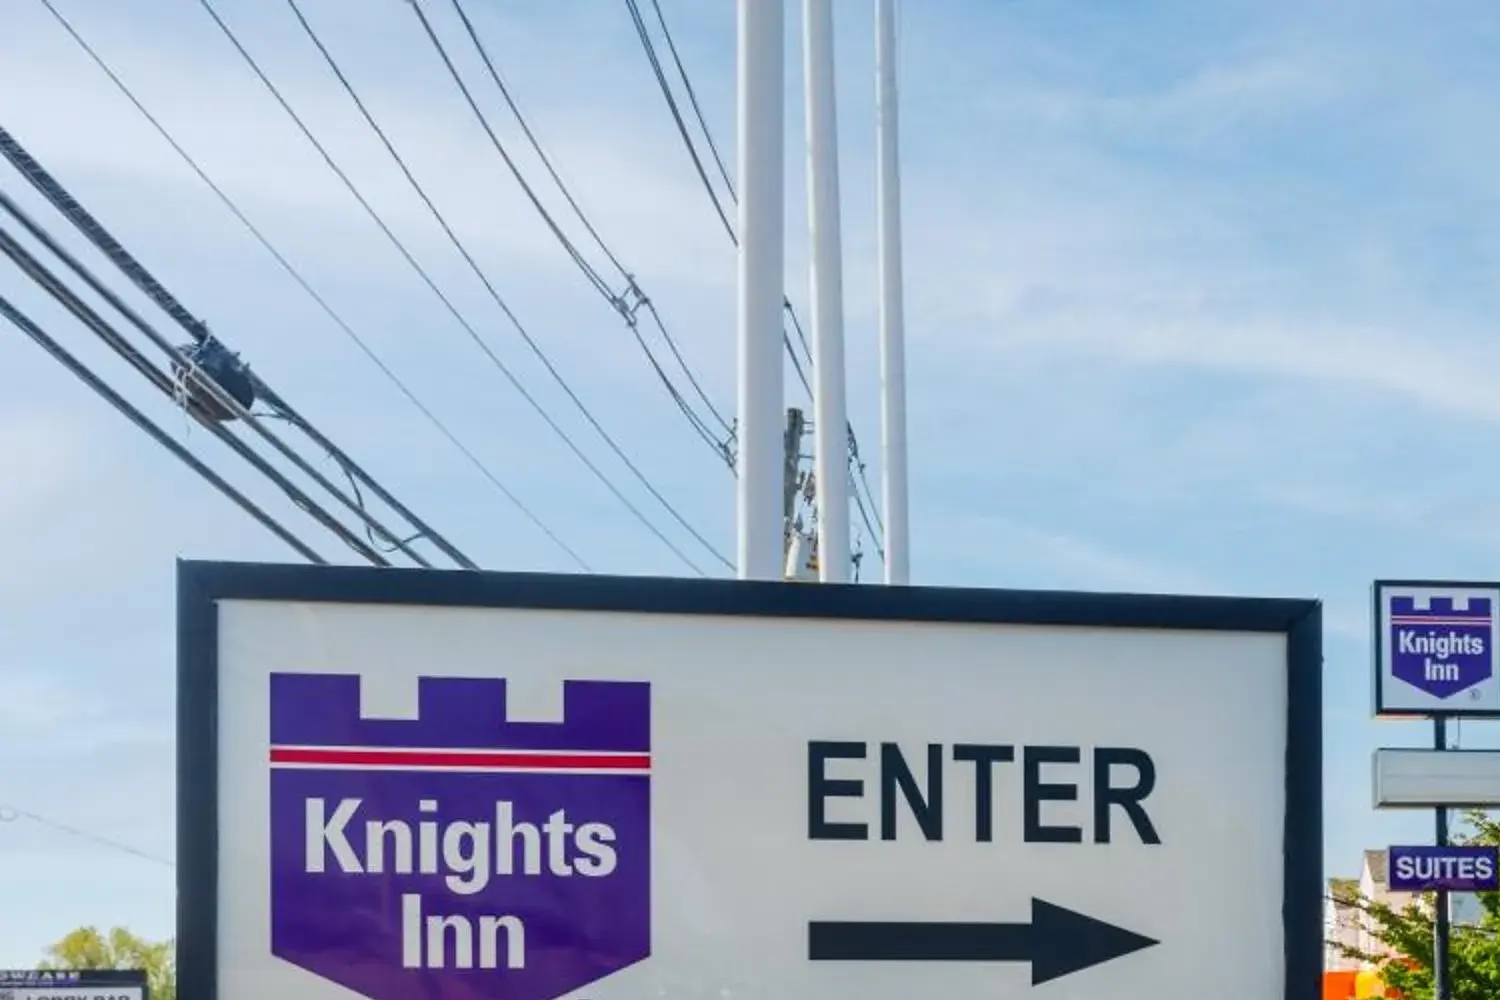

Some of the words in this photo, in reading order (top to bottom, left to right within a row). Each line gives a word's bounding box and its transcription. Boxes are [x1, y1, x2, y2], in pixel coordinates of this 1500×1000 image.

[1399, 630, 1484, 659] Knights
[1425, 657, 1459, 681] Inn
[808, 740, 1162, 845] ENTER
[305, 797, 618, 896] Knights
[1396, 856, 1493, 880] SUITES
[403, 892, 526, 970] Inn
